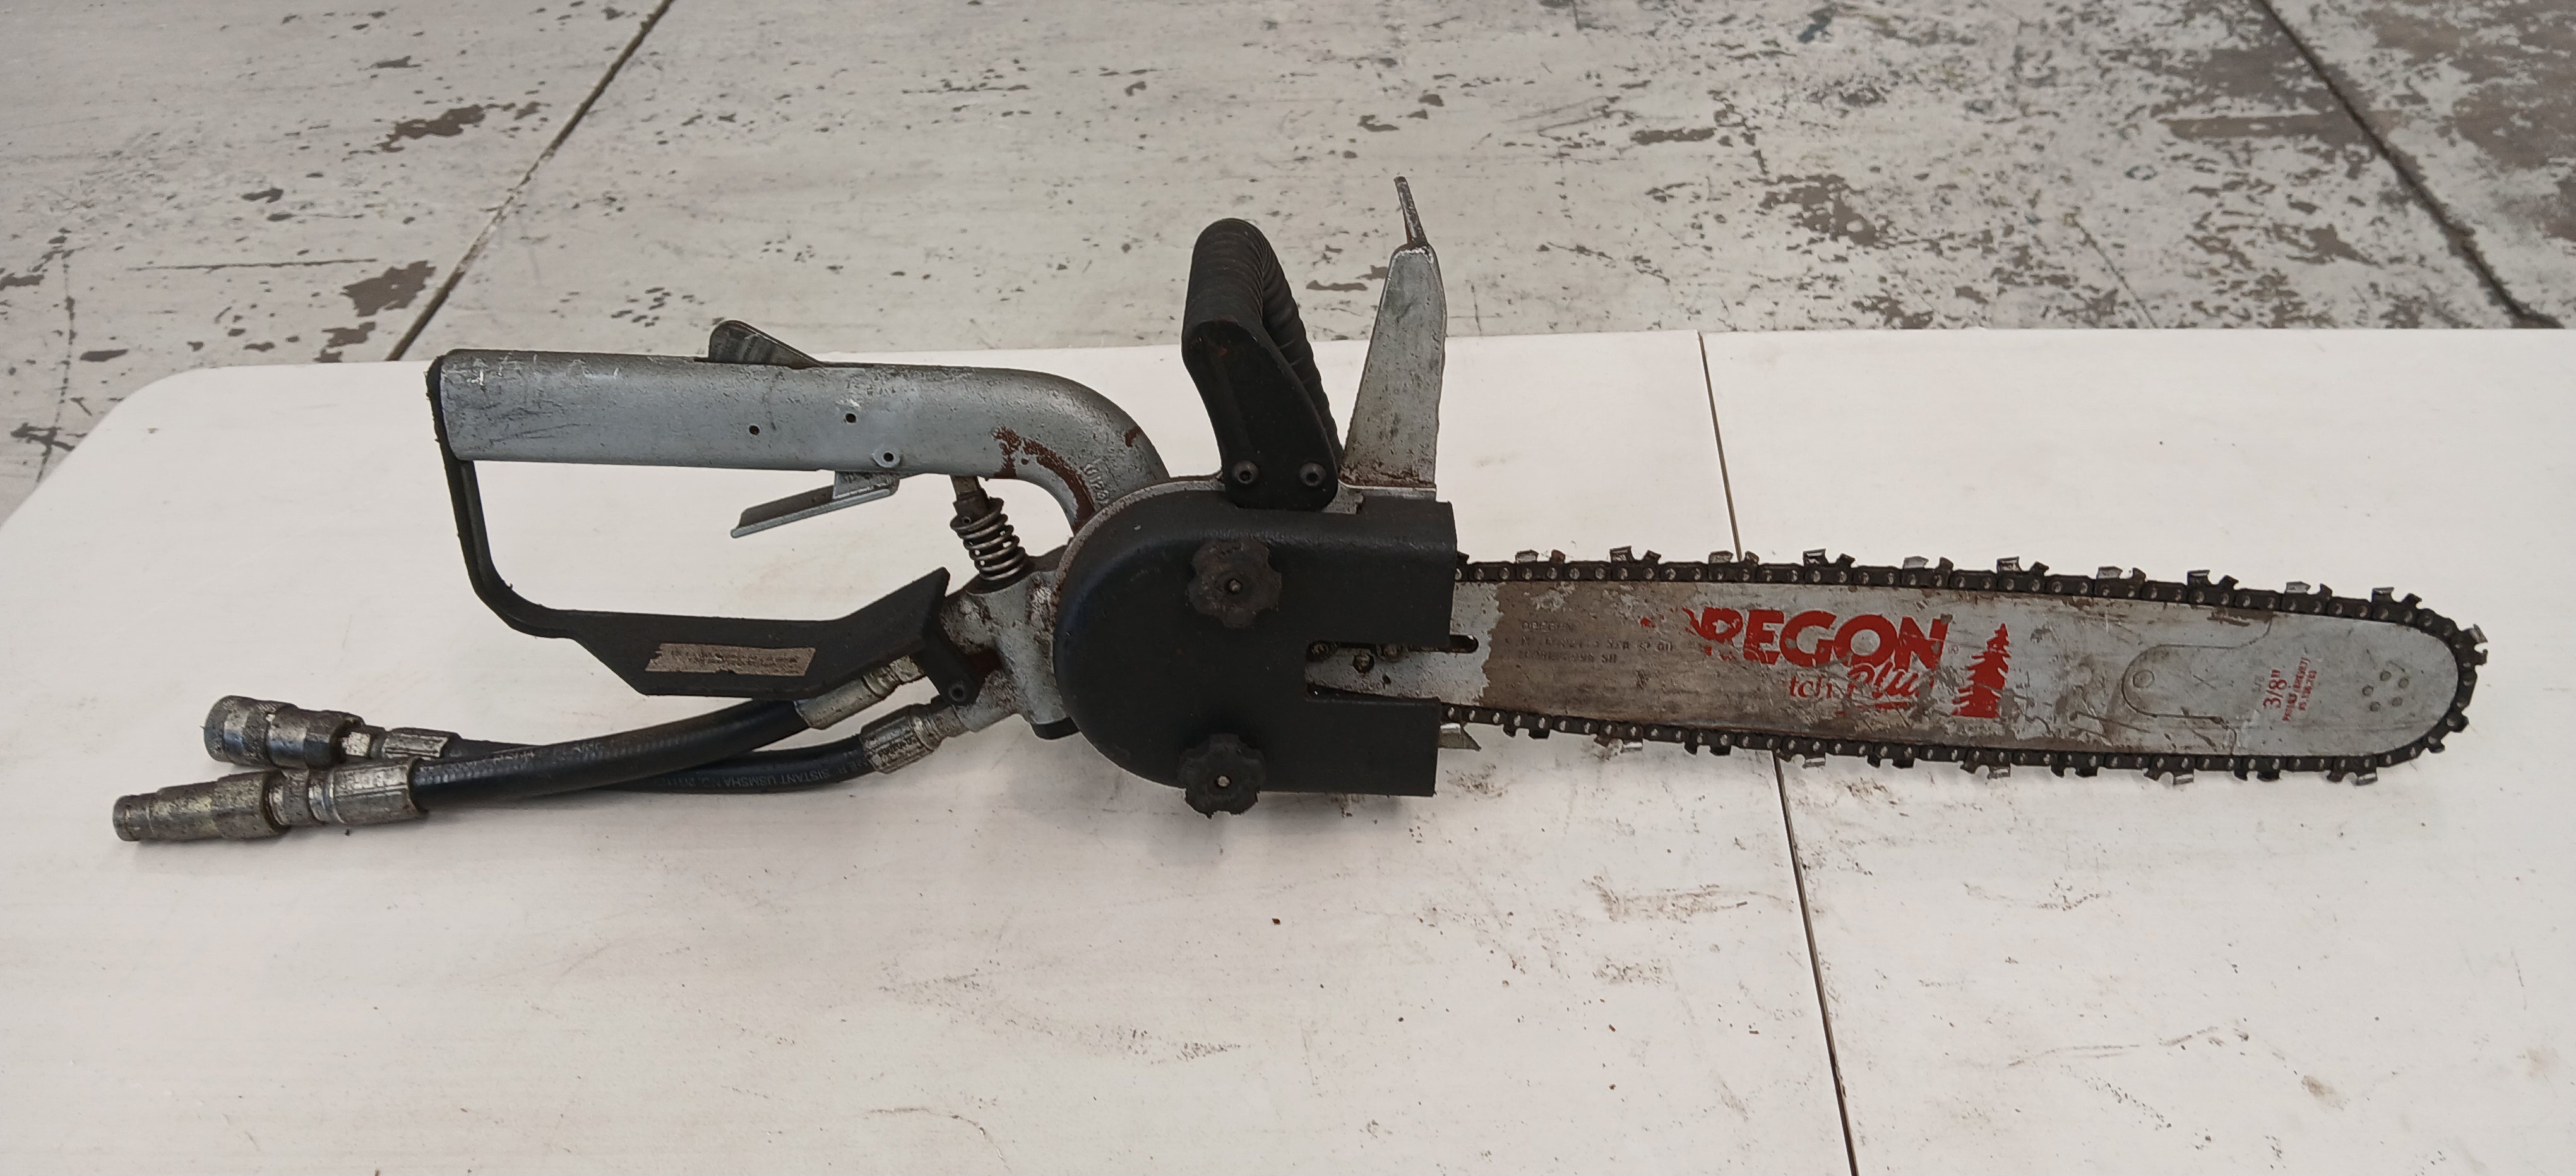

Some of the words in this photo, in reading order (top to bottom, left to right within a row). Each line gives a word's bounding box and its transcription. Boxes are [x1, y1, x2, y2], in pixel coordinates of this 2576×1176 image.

[1681, 606, 1950, 671] REGON
[1847, 661, 1935, 699] Plu
[2262, 669, 2287, 709] 3/8"
